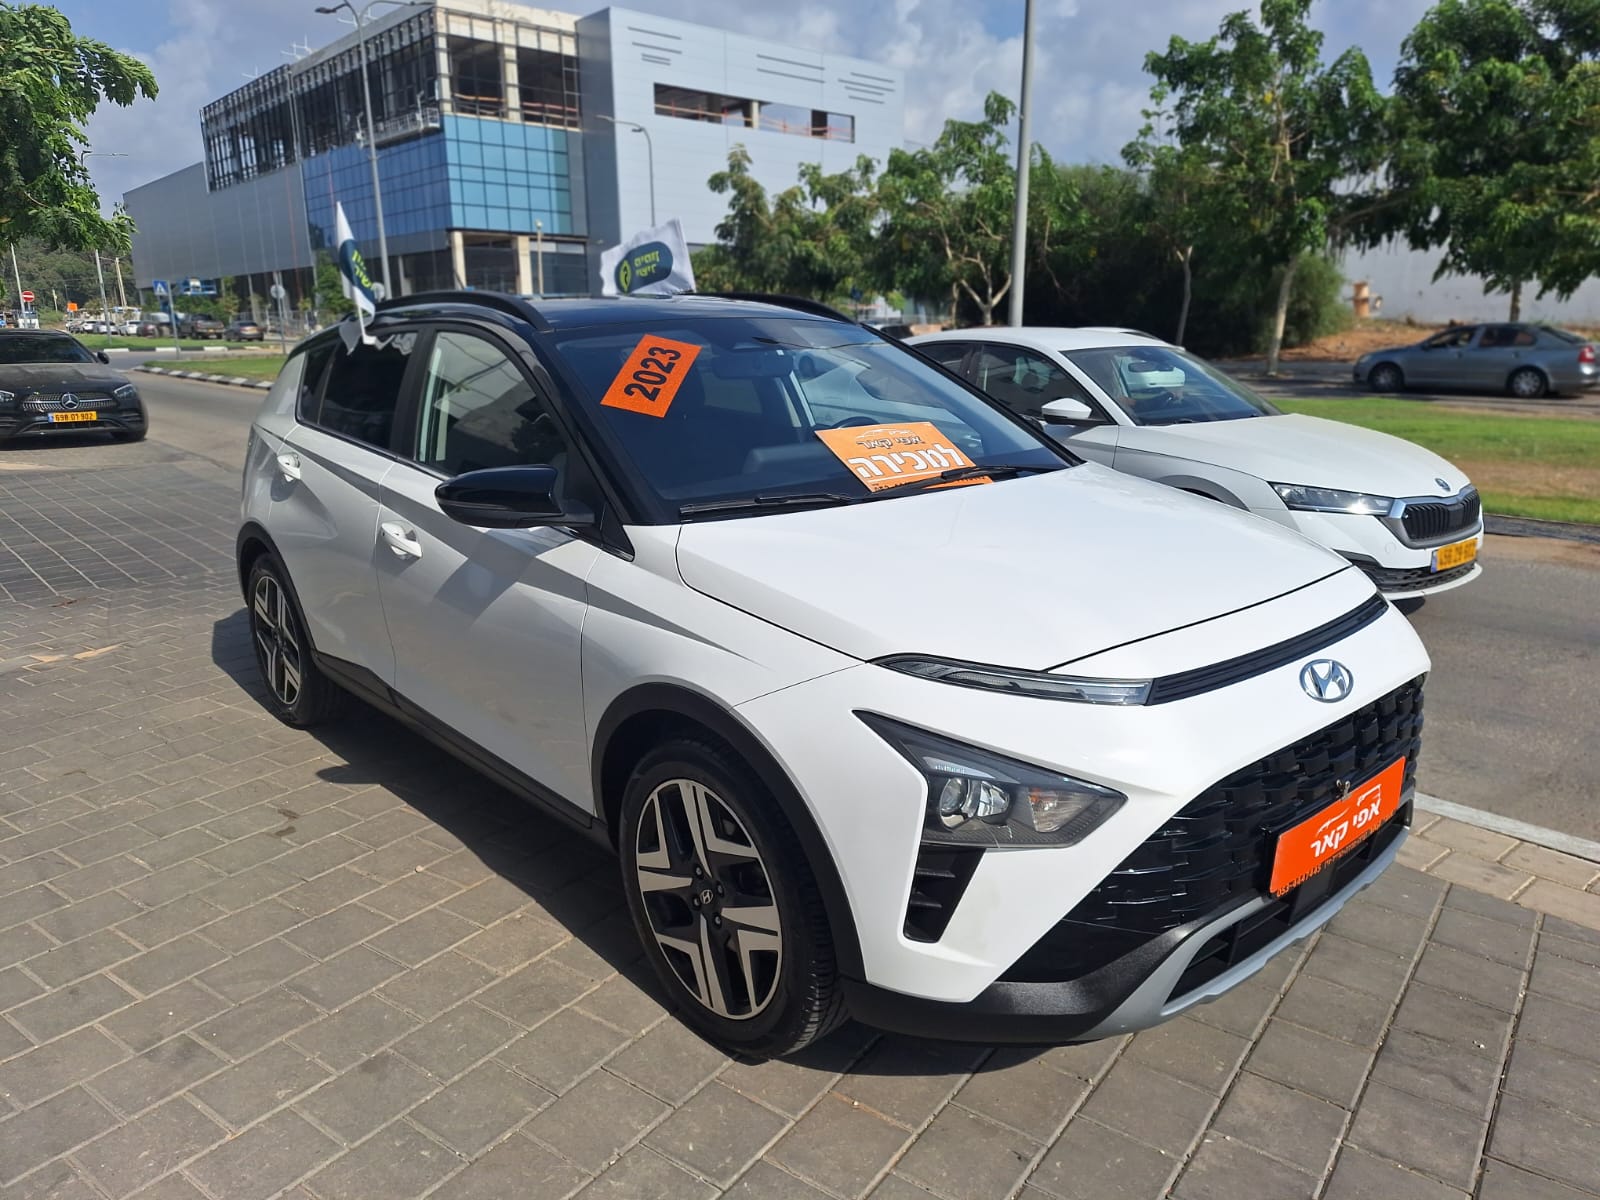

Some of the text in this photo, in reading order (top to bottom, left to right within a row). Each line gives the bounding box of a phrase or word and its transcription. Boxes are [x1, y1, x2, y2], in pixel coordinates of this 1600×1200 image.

[623, 346, 682, 402] 2023
[848, 442, 967, 479] למכירה
[856, 435, 922, 450] אפי קאר
[1352, 797, 1382, 829] אפי
[1310, 820, 1349, 858] קאר
